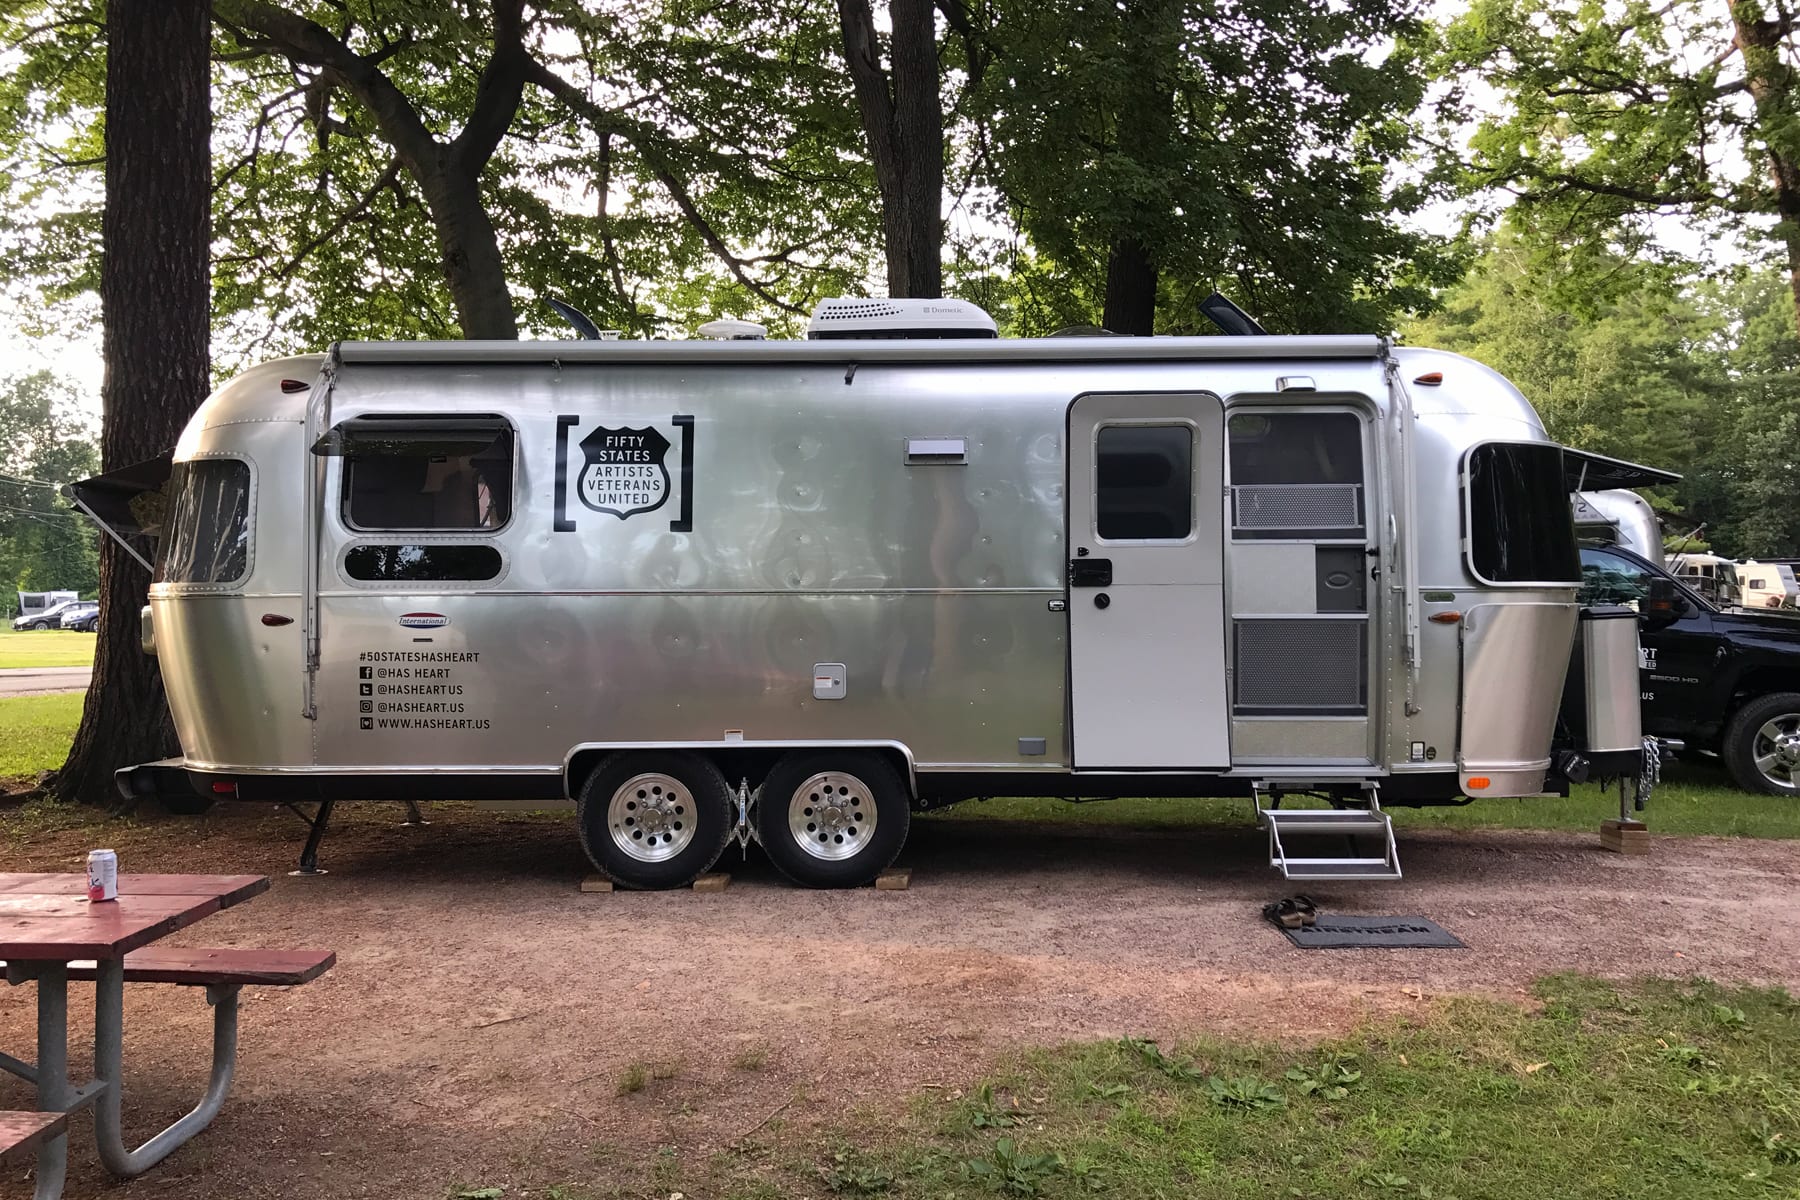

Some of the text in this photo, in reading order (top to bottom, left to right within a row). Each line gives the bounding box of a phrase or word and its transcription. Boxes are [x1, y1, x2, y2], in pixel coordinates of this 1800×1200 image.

[606, 436, 645, 447] FIFTY
[600, 451, 650, 461] STATES
[595, 467, 653, 477] ARTISTS
[588, 480, 660, 490] VETERANS
[598, 494, 649, 504] UNITED
[399, 617, 447, 625] International
[359, 652, 480, 662] #50STATESHASHEART
[377, 668, 410, 678] @HAS
[415, 669, 450, 678] HEART
[377, 703, 465, 713] @HASHEART.US
[378, 719, 490, 729] WWW.HASHEART.US
